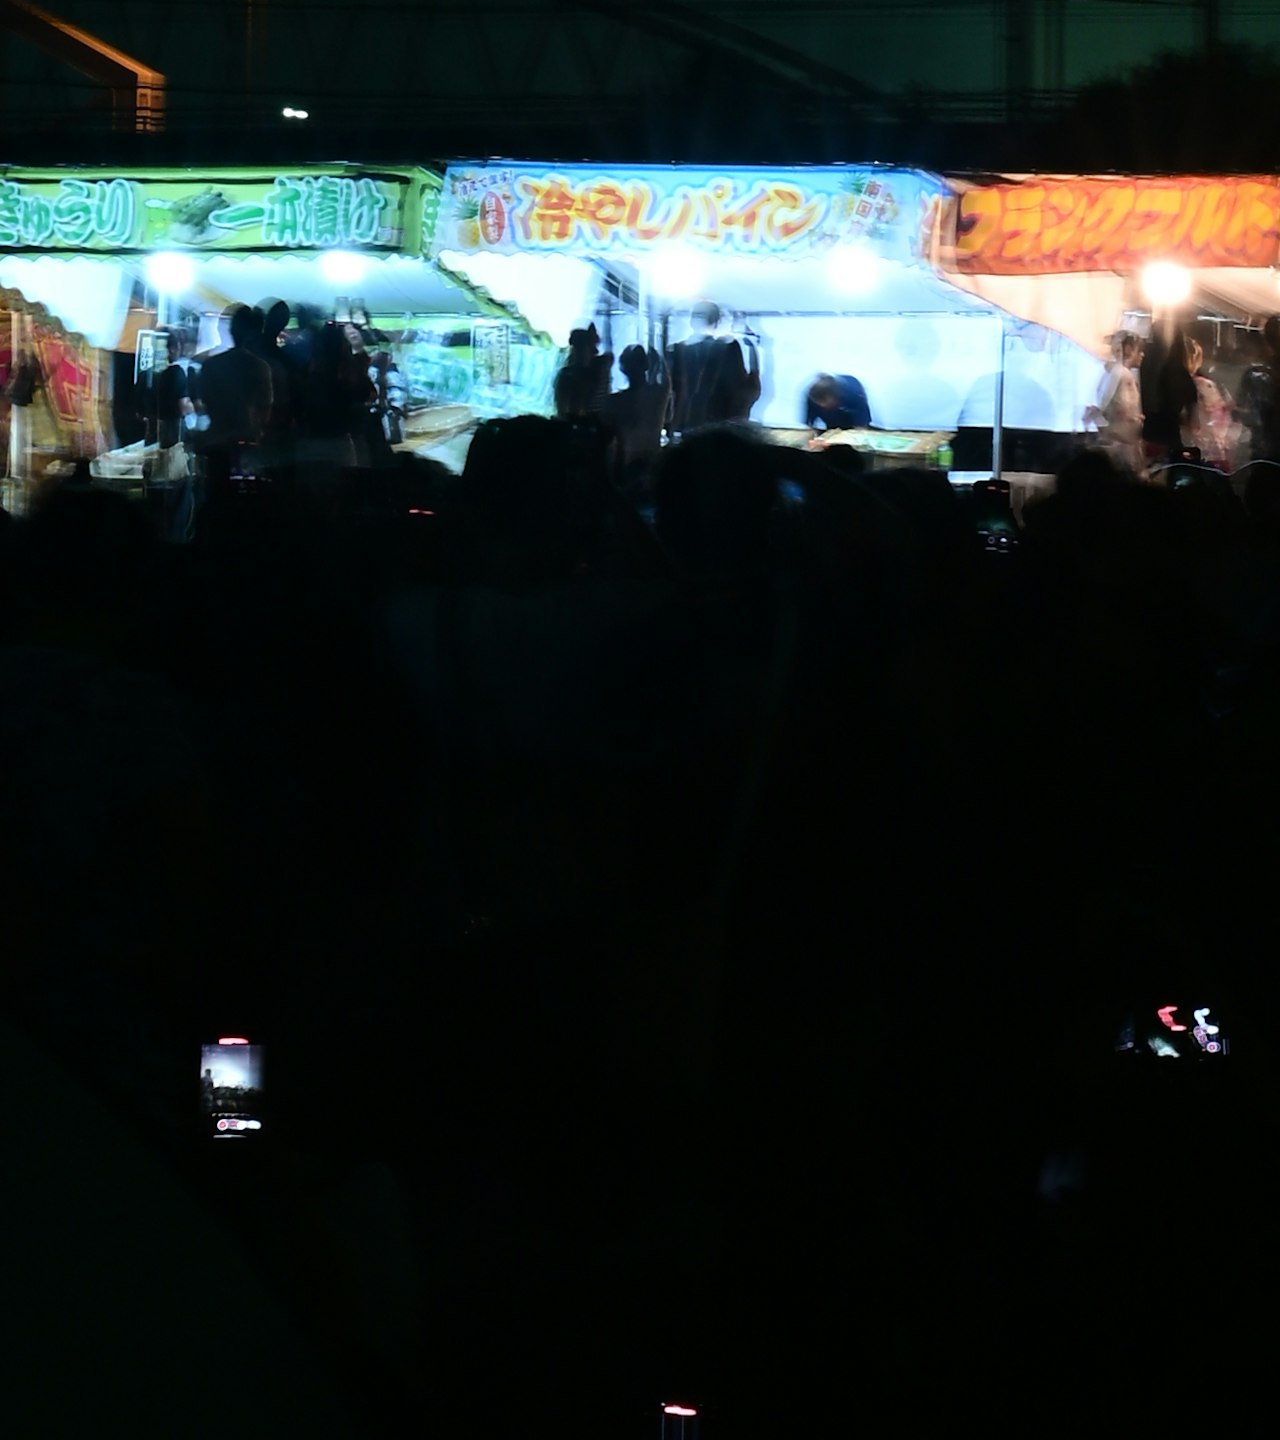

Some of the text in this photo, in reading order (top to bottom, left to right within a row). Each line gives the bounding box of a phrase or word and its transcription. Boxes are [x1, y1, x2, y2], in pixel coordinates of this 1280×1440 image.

[209, 176, 387, 246] 一本漬け
[513, 174, 830, 250] 冷やしパイン
